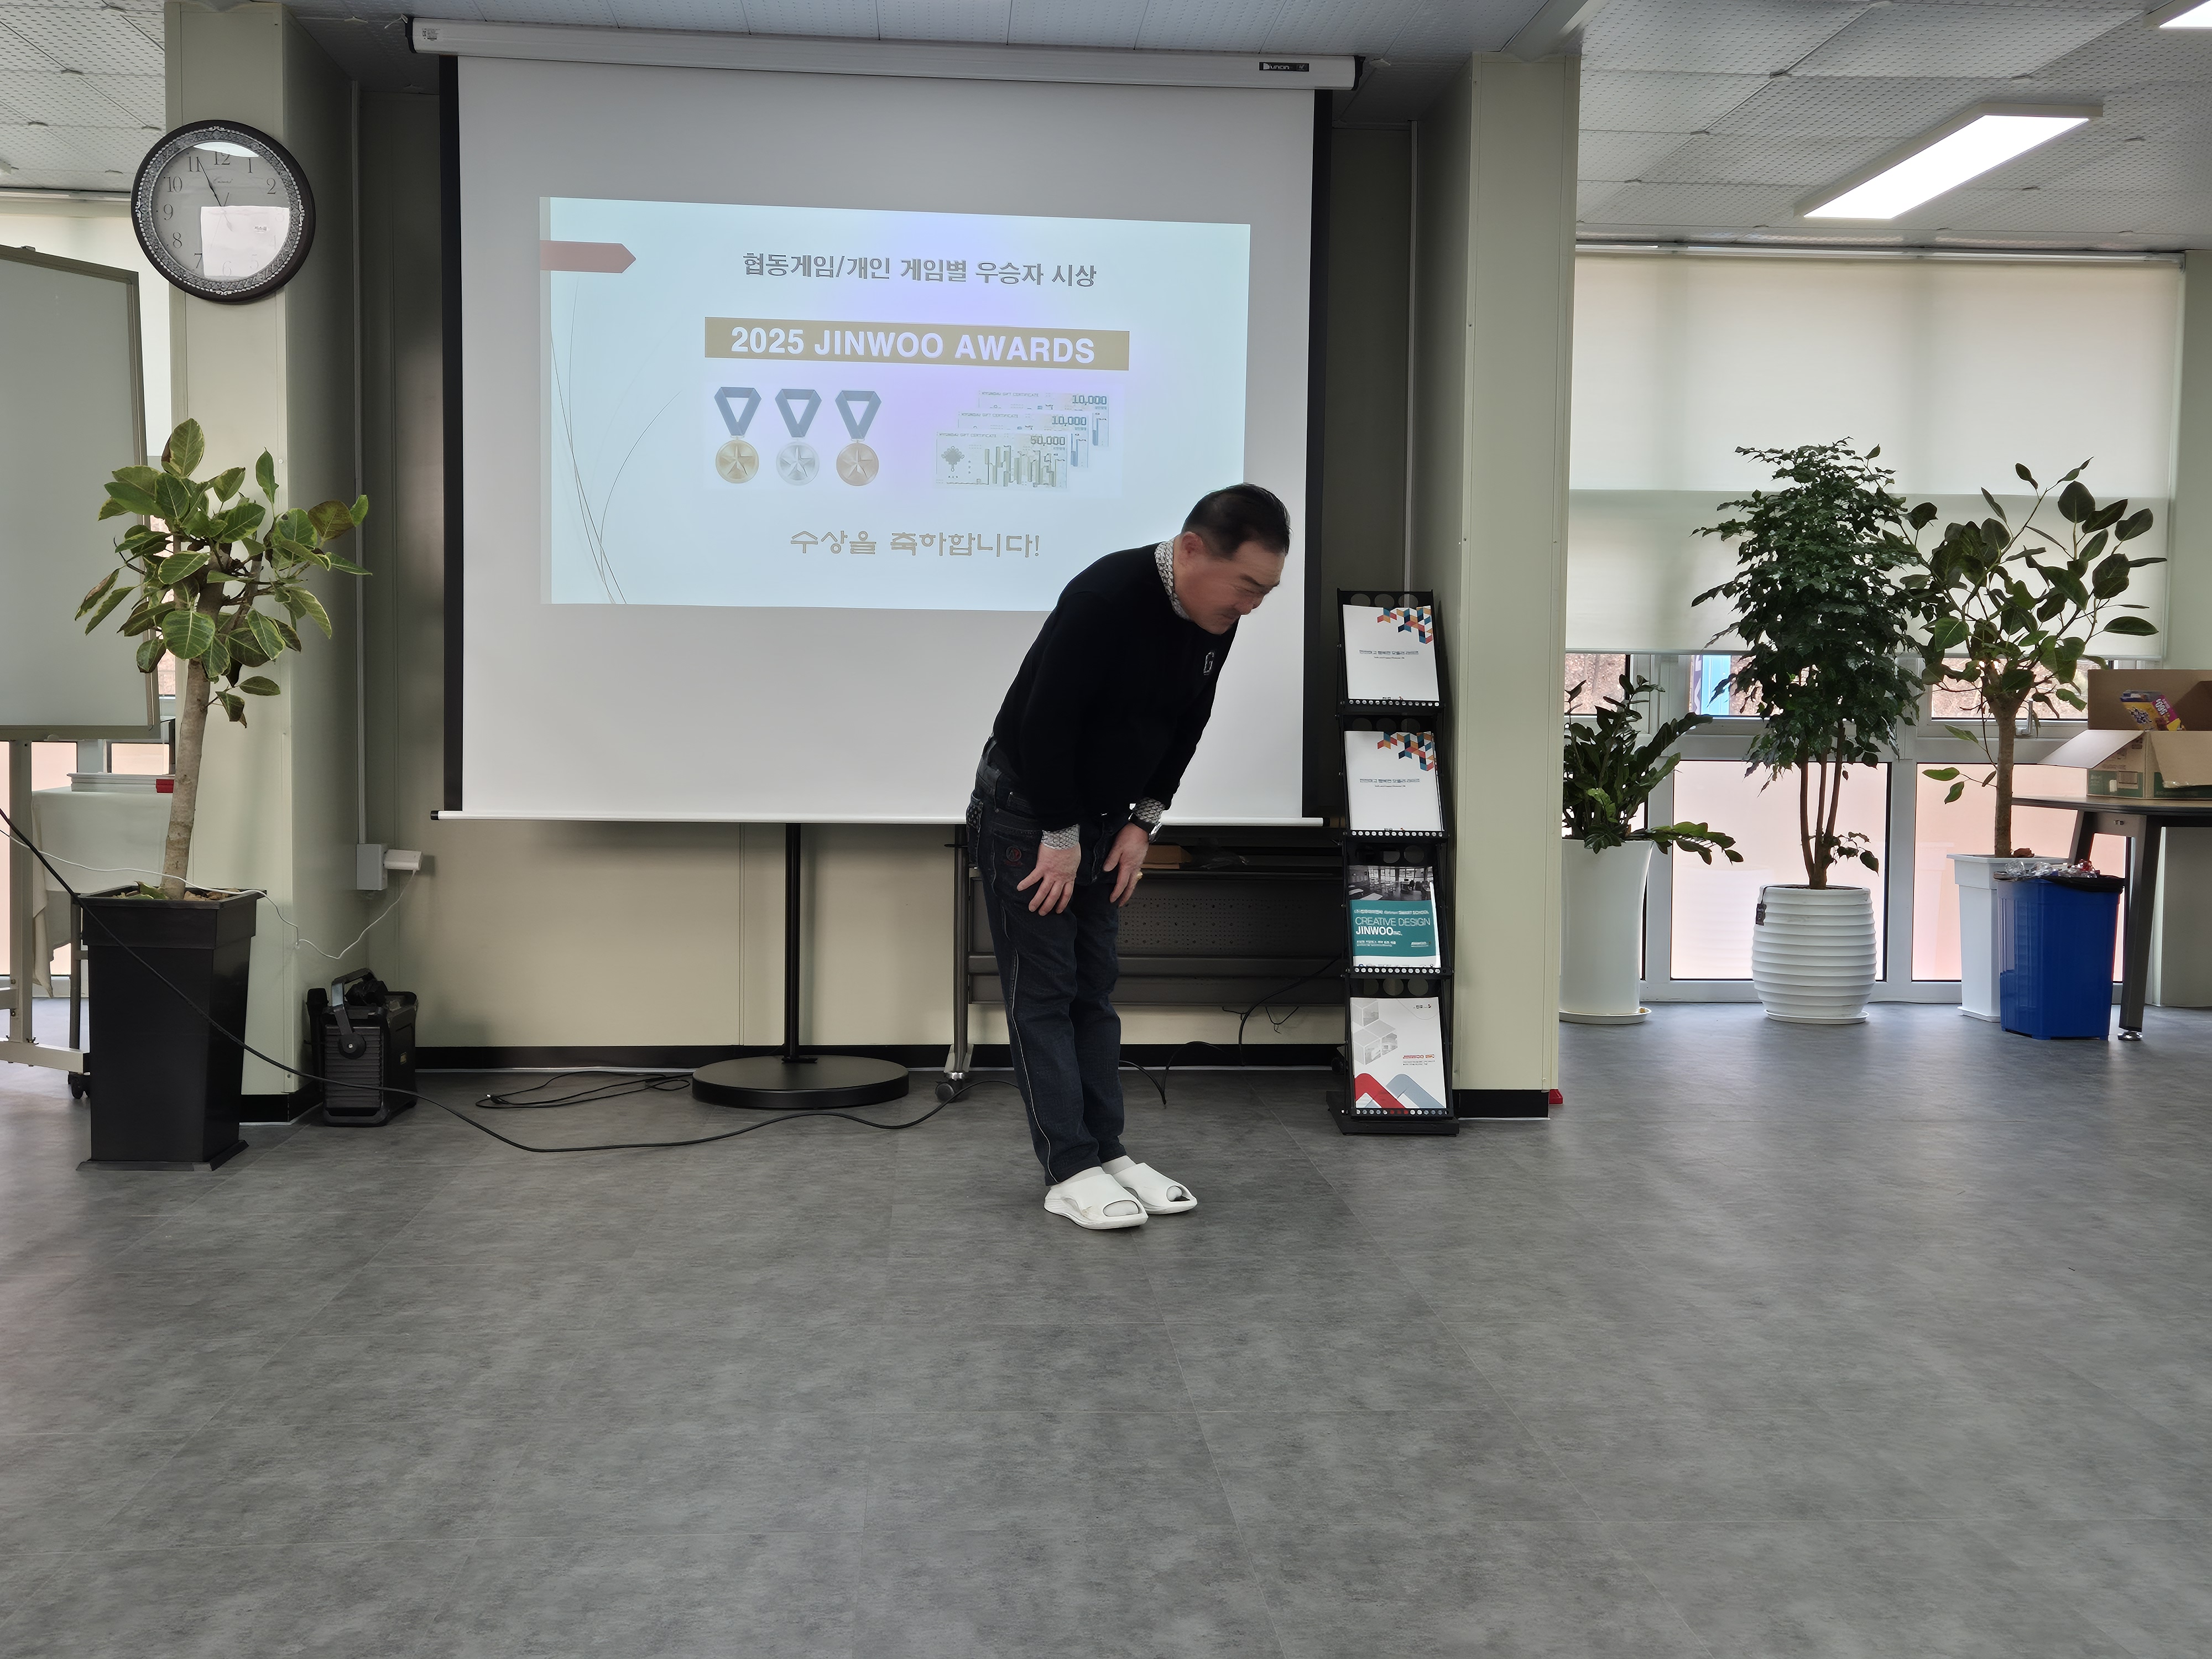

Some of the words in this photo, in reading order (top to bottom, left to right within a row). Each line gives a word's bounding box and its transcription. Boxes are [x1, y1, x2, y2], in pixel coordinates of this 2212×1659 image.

[188, 156, 200, 172] 11
[214, 150, 231, 165] 12
[248, 158, 253, 174] 1
[167, 176, 182, 193] 10
[267, 178, 276, 195] 2
[163, 204, 173, 220] 9
[173, 232, 182, 248] 8
[194, 252, 203, 268] 7
[743, 253, 890, 279] 협동게임/개인
[900, 259, 967, 282] 게임별
[975, 262, 1044, 285] 우승자
[1051, 264, 1097, 287] 시상
[731, 327, 804, 354] 2025
[814, 330, 944, 358] JINWOO
[954, 334, 1095, 363] AWARDS
[1072, 395, 1107, 405] 10,000
[1052, 415, 1087, 426] 10,000
[1030, 435, 1065, 446] 50,000
[790, 530, 877, 555] 수상을
[890, 531, 1040, 558] 축하합니다!
[1355, 917, 1396, 926] CREATIVE
[1398, 917, 1431, 926] DESIGN
[1355, 925, 1394, 936] JINWOO
